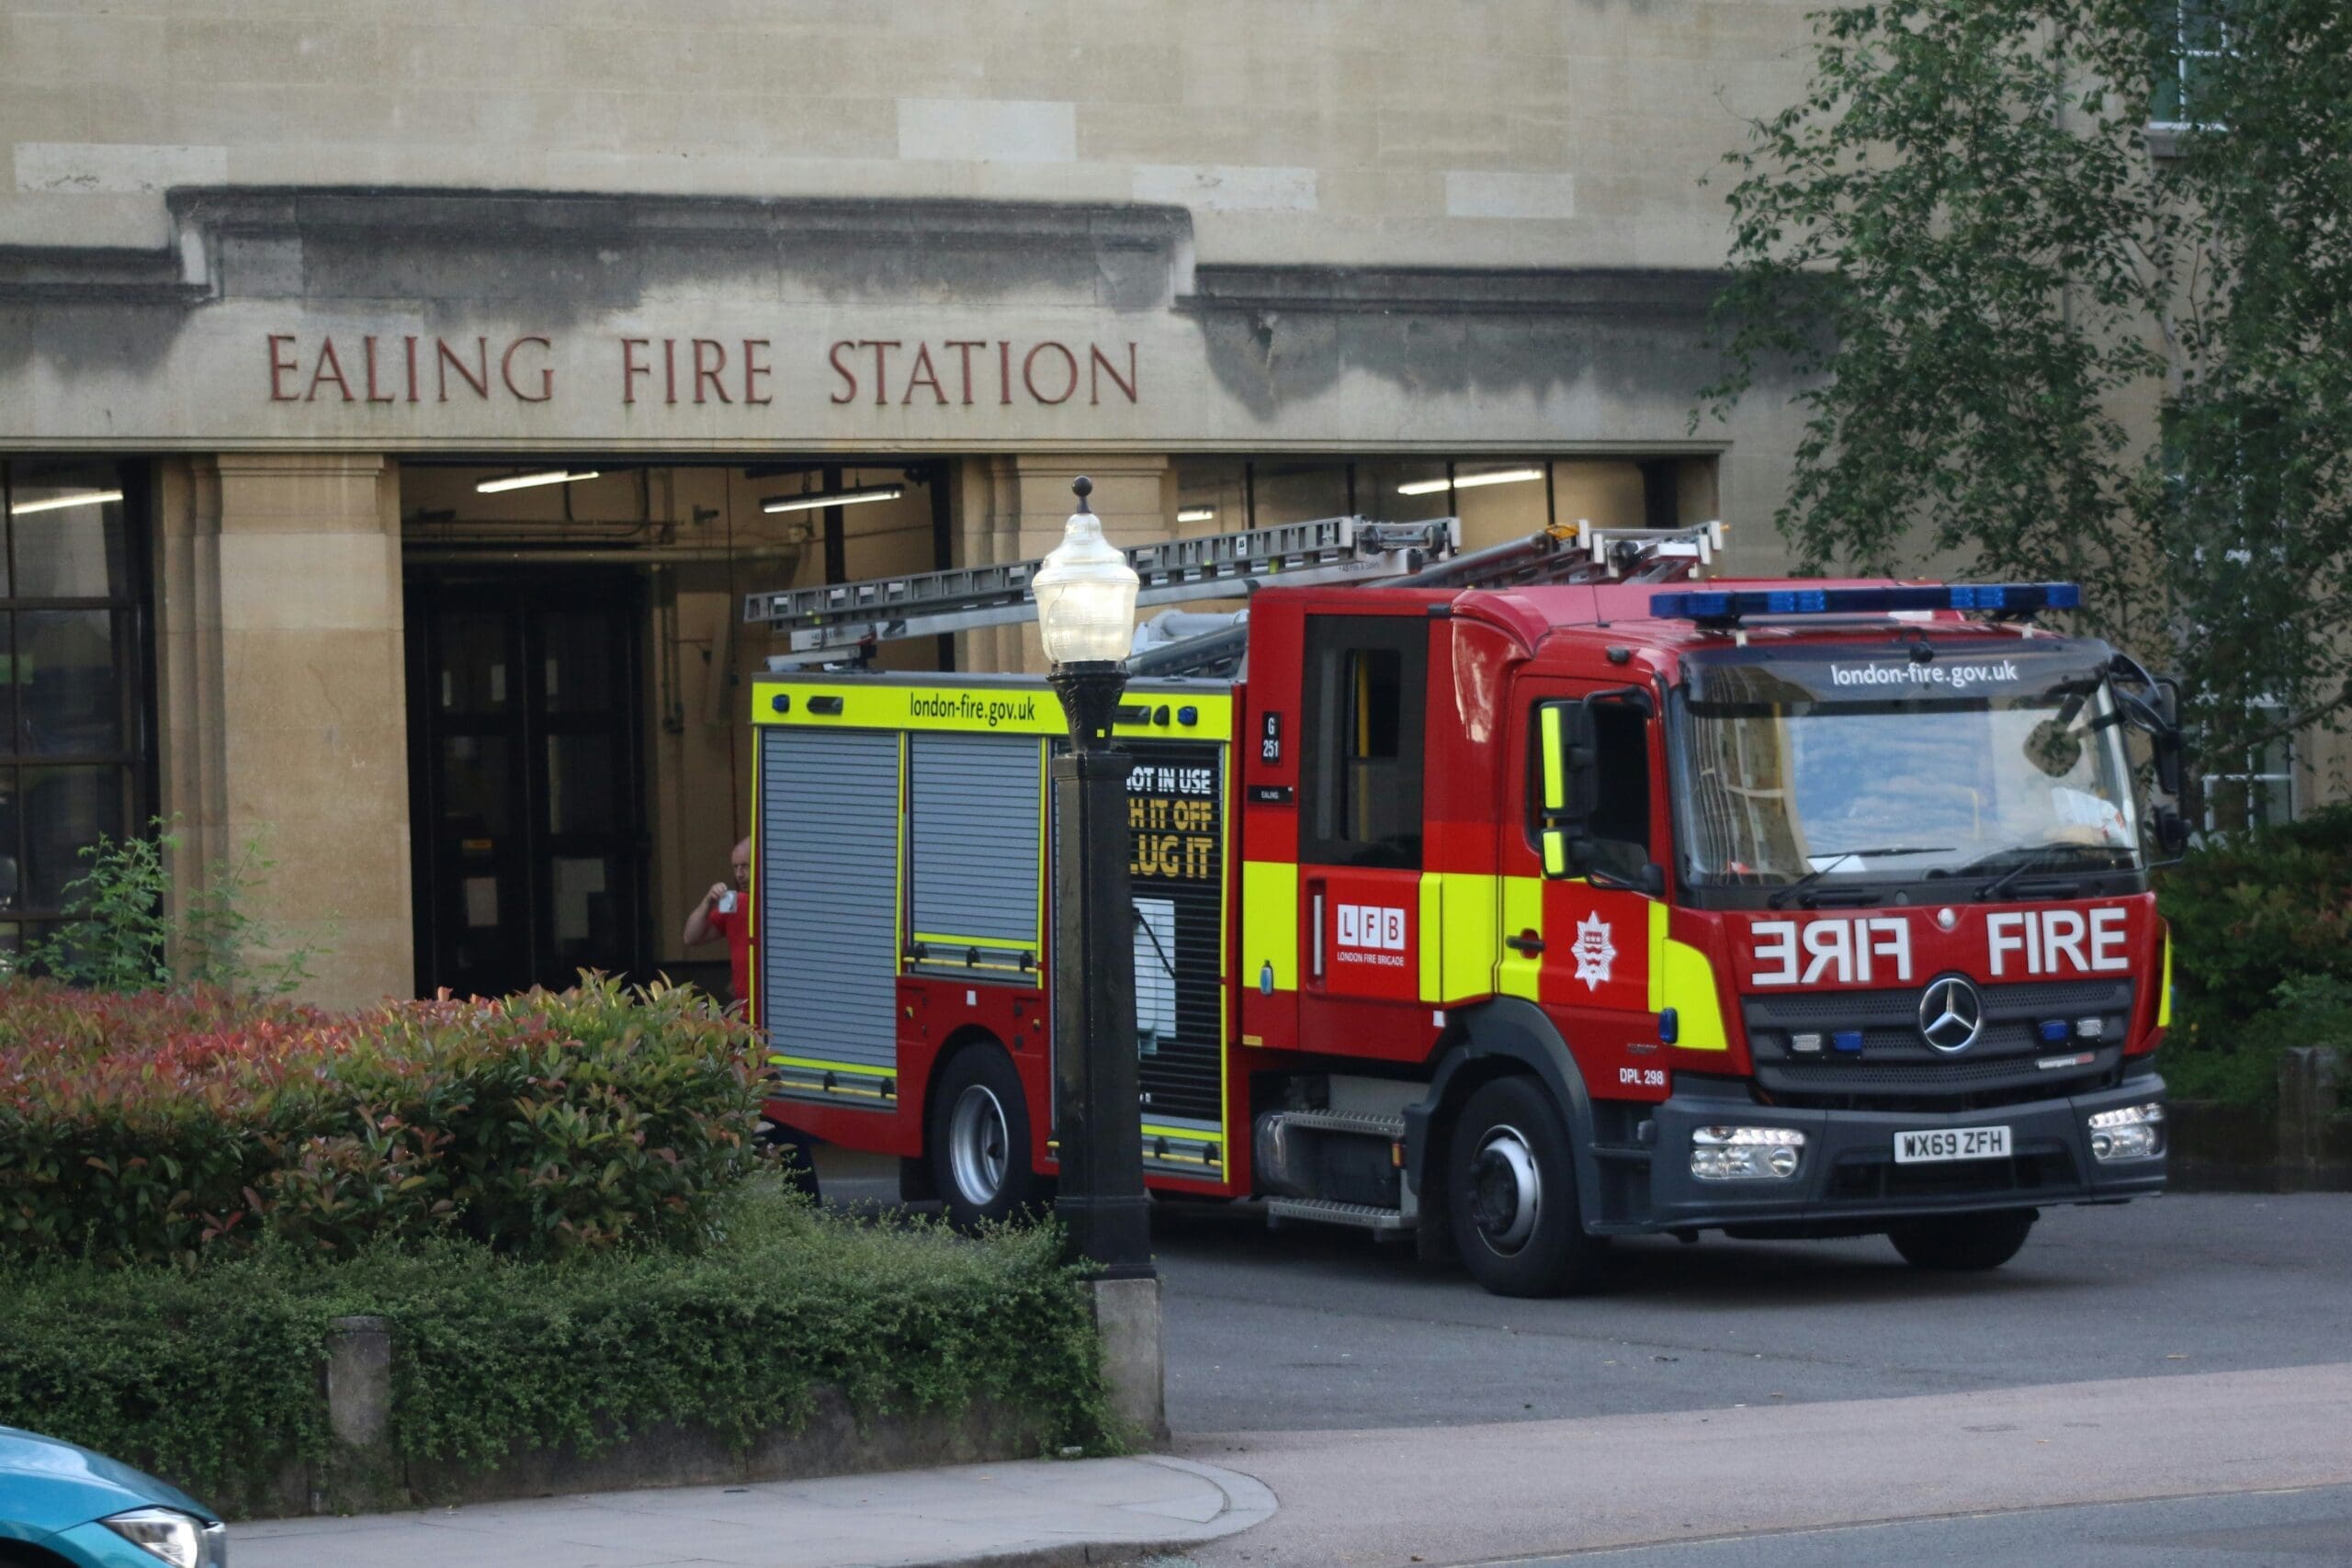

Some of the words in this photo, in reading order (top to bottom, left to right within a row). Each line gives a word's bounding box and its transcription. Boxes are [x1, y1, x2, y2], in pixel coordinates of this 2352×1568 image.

[268, 334, 554, 402] EALING
[621, 338, 773, 405] FIRE
[830, 341, 1137, 405] STATION
[1831, 660, 2018, 687] london-fire.gov.uk
[910, 693, 1035, 727] london-fire.gov.uk
[1268, 717, 1275, 735] G
[1263, 739, 1279, 757] 251
[1159, 768, 1175, 793] IN
[1180, 768, 1211, 794] USE
[1127, 797, 1145, 828] H
[1150, 799, 1169, 829] IT
[1173, 800, 1212, 831] OFF
[1186, 837, 1213, 878] IT
[1986, 908, 2129, 976] FIRE
[1337, 951, 1363, 963] LONDON
[1364, 953, 1376, 964] FIRE
[1377, 955, 1404, 966] BRIGADE
[1620, 1067, 1641, 1084] DPL
[1645, 1069, 1663, 1085] 298
[1904, 1134, 1957, 1156] WX69
[1963, 1131, 2002, 1154] ZFH
